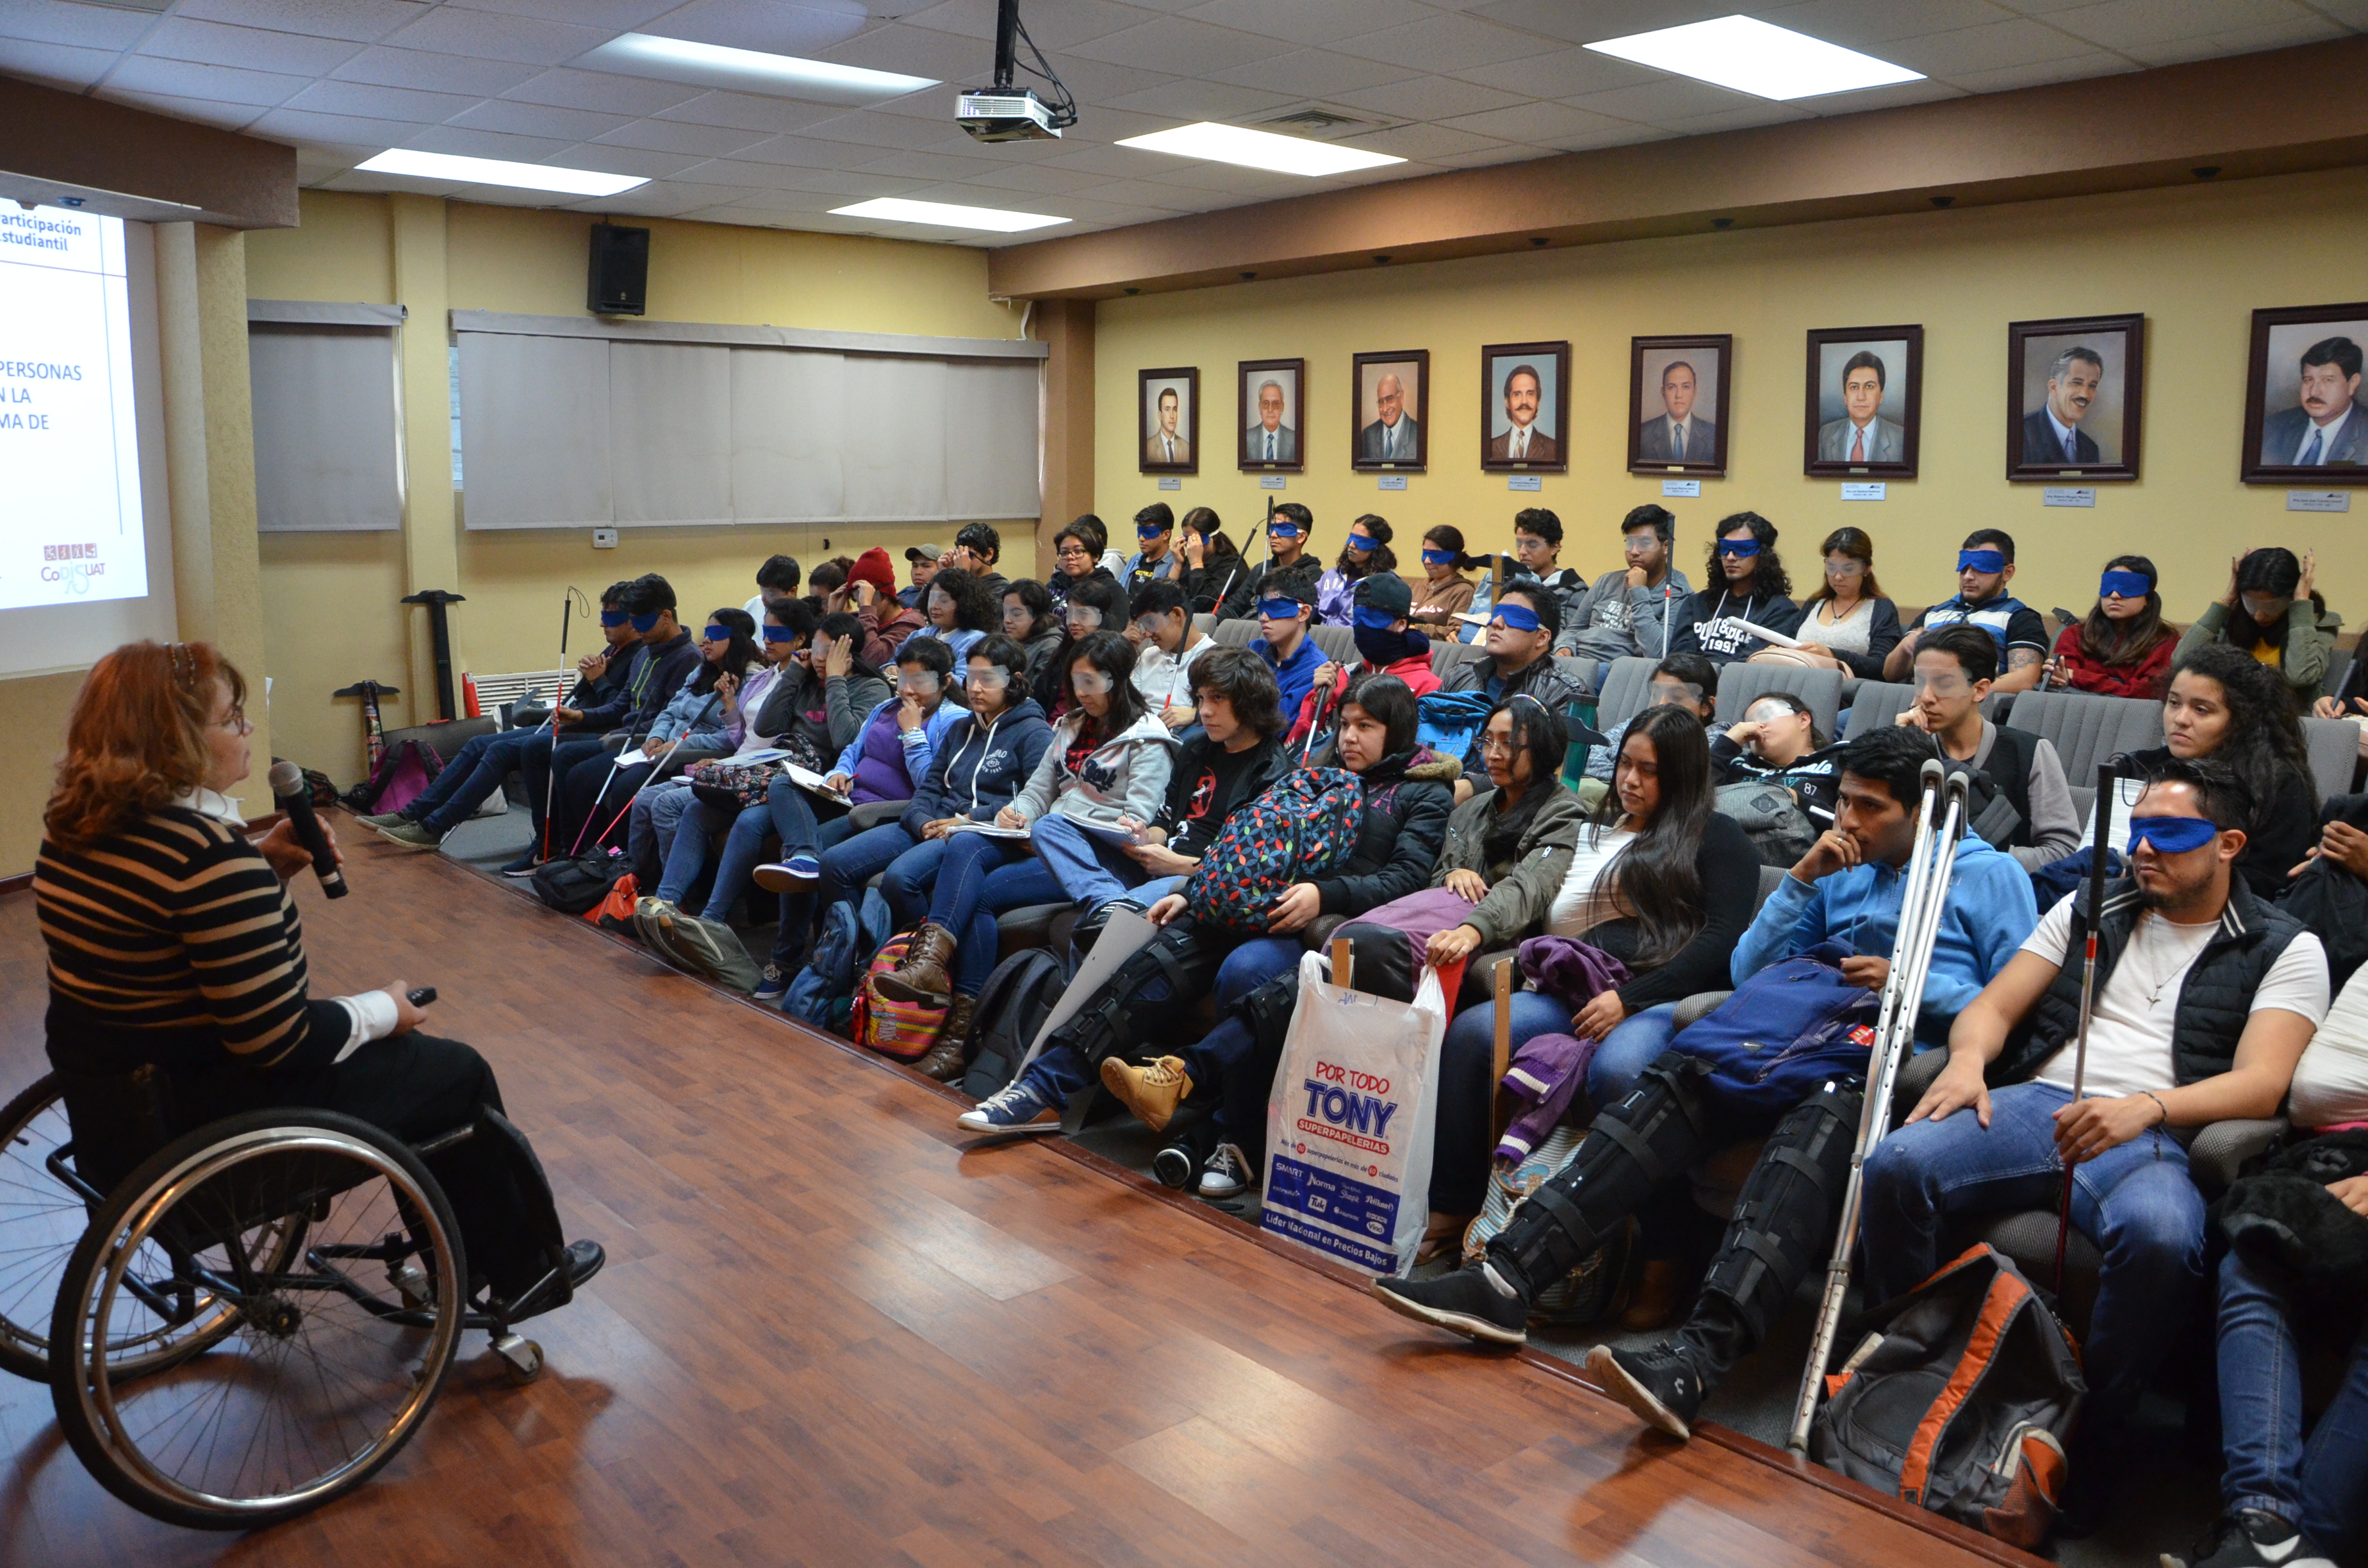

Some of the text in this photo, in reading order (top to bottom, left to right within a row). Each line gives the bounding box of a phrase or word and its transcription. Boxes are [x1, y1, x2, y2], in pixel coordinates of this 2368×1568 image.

[0, 213, 81, 236] articipación
[0, 231, 68, 251] studiantil
[12, 388, 31, 404] LA
[29, 414, 49, 430] DE
[1804, 782, 1818, 796] 87
[1315, 1061, 1390, 1095] POR TODO
[1304, 1078, 1398, 1139] TONY
[1298, 1120, 1388, 1154] SUPERPAPELERIAS
[1276, 1162, 1304, 1178] SMART
[1360, 1163, 1368, 1173] de
[1306, 1172, 1336, 1191] Norma
[1310, 1197, 1326, 1211] Tuk
[1365, 1195, 1389, 1209] Pelikan
[1369, 1222, 1383, 1234] Vinci
[1322, 1235, 1332, 1246] en
[1333, 1238, 1363, 1258] Precios
[1365, 1250, 1388, 1266] Bajos
